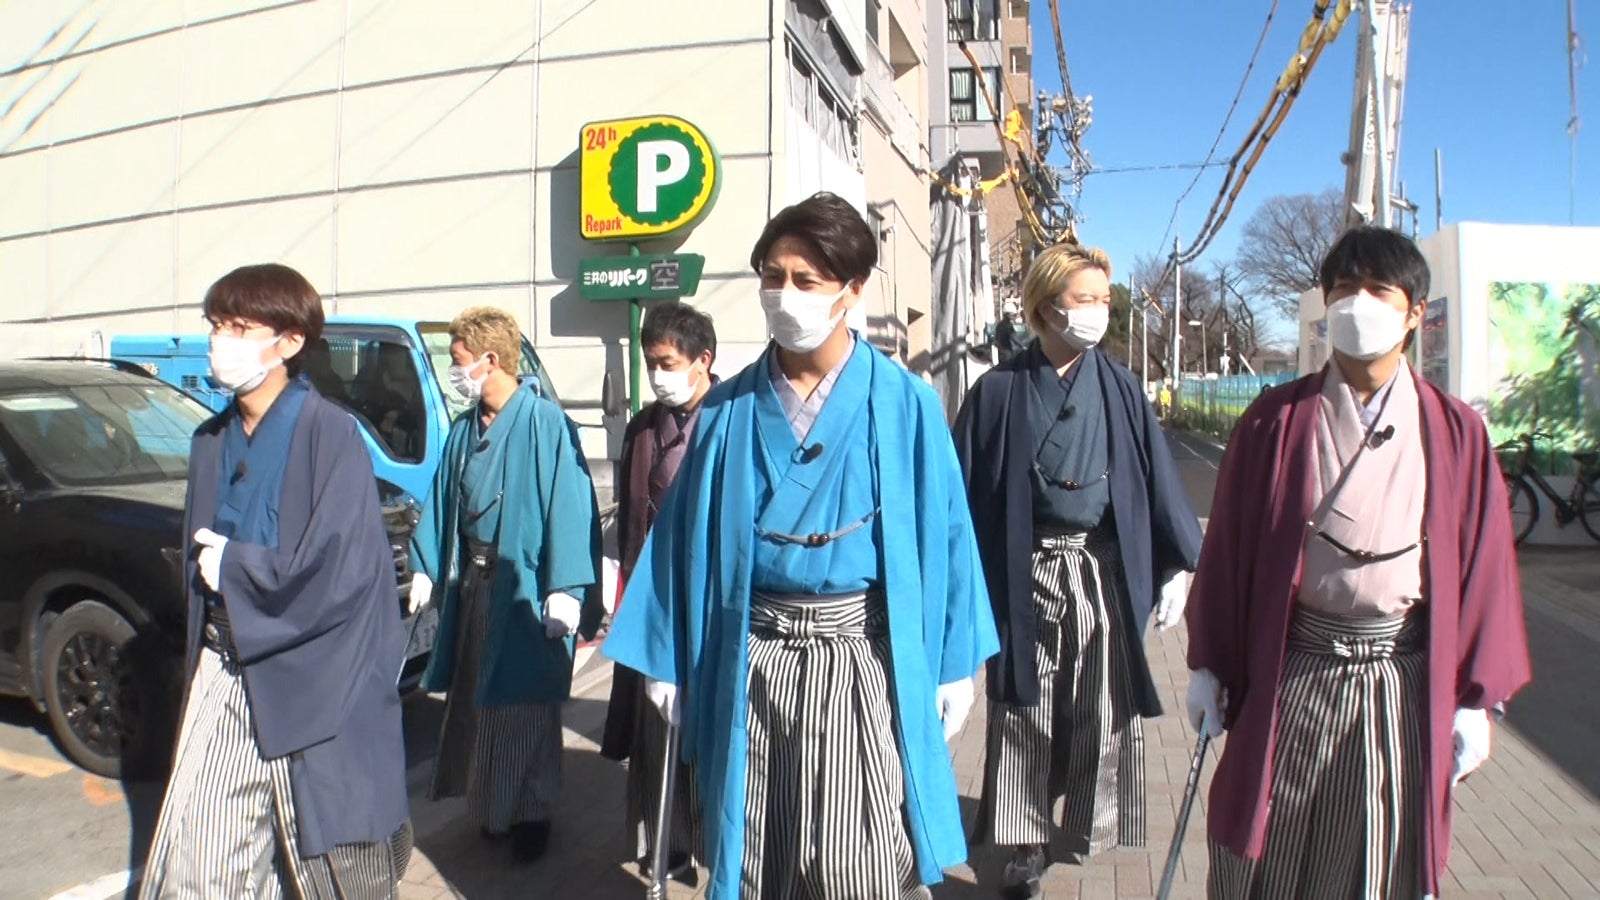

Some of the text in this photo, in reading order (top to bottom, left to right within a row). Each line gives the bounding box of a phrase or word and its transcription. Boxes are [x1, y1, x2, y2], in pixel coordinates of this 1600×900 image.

[636, 140, 690, 213] P
[585, 214, 622, 234] Repark
[583, 260, 680, 290] 三井のリパーク 空
